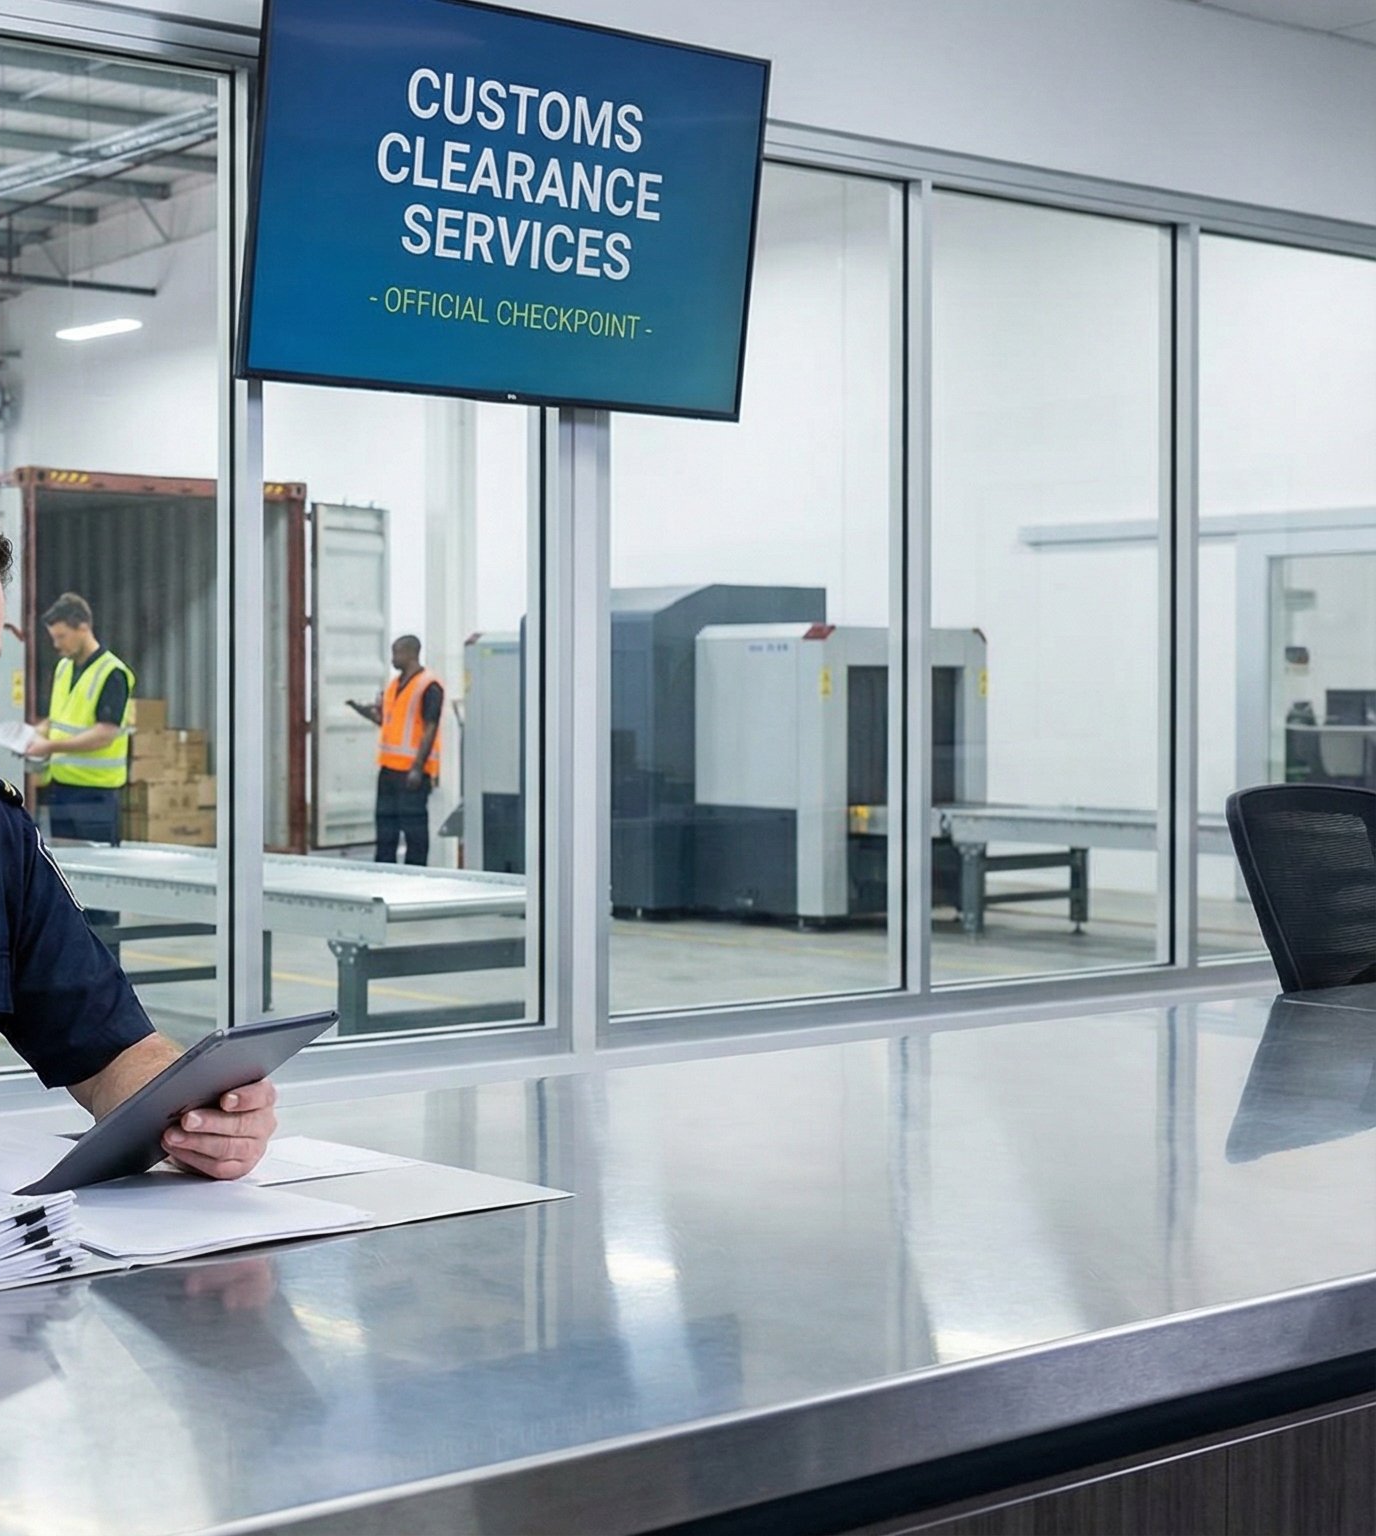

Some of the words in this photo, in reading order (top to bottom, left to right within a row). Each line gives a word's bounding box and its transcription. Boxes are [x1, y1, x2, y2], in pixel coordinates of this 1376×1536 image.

[407, 68, 644, 153] CUSTOMS
[377, 132, 663, 222] CLEARANCE
[401, 203, 632, 281] SERVICES
[384, 287, 490, 323] OFFICIAL
[496, 300, 641, 339] CHECKPOINT
